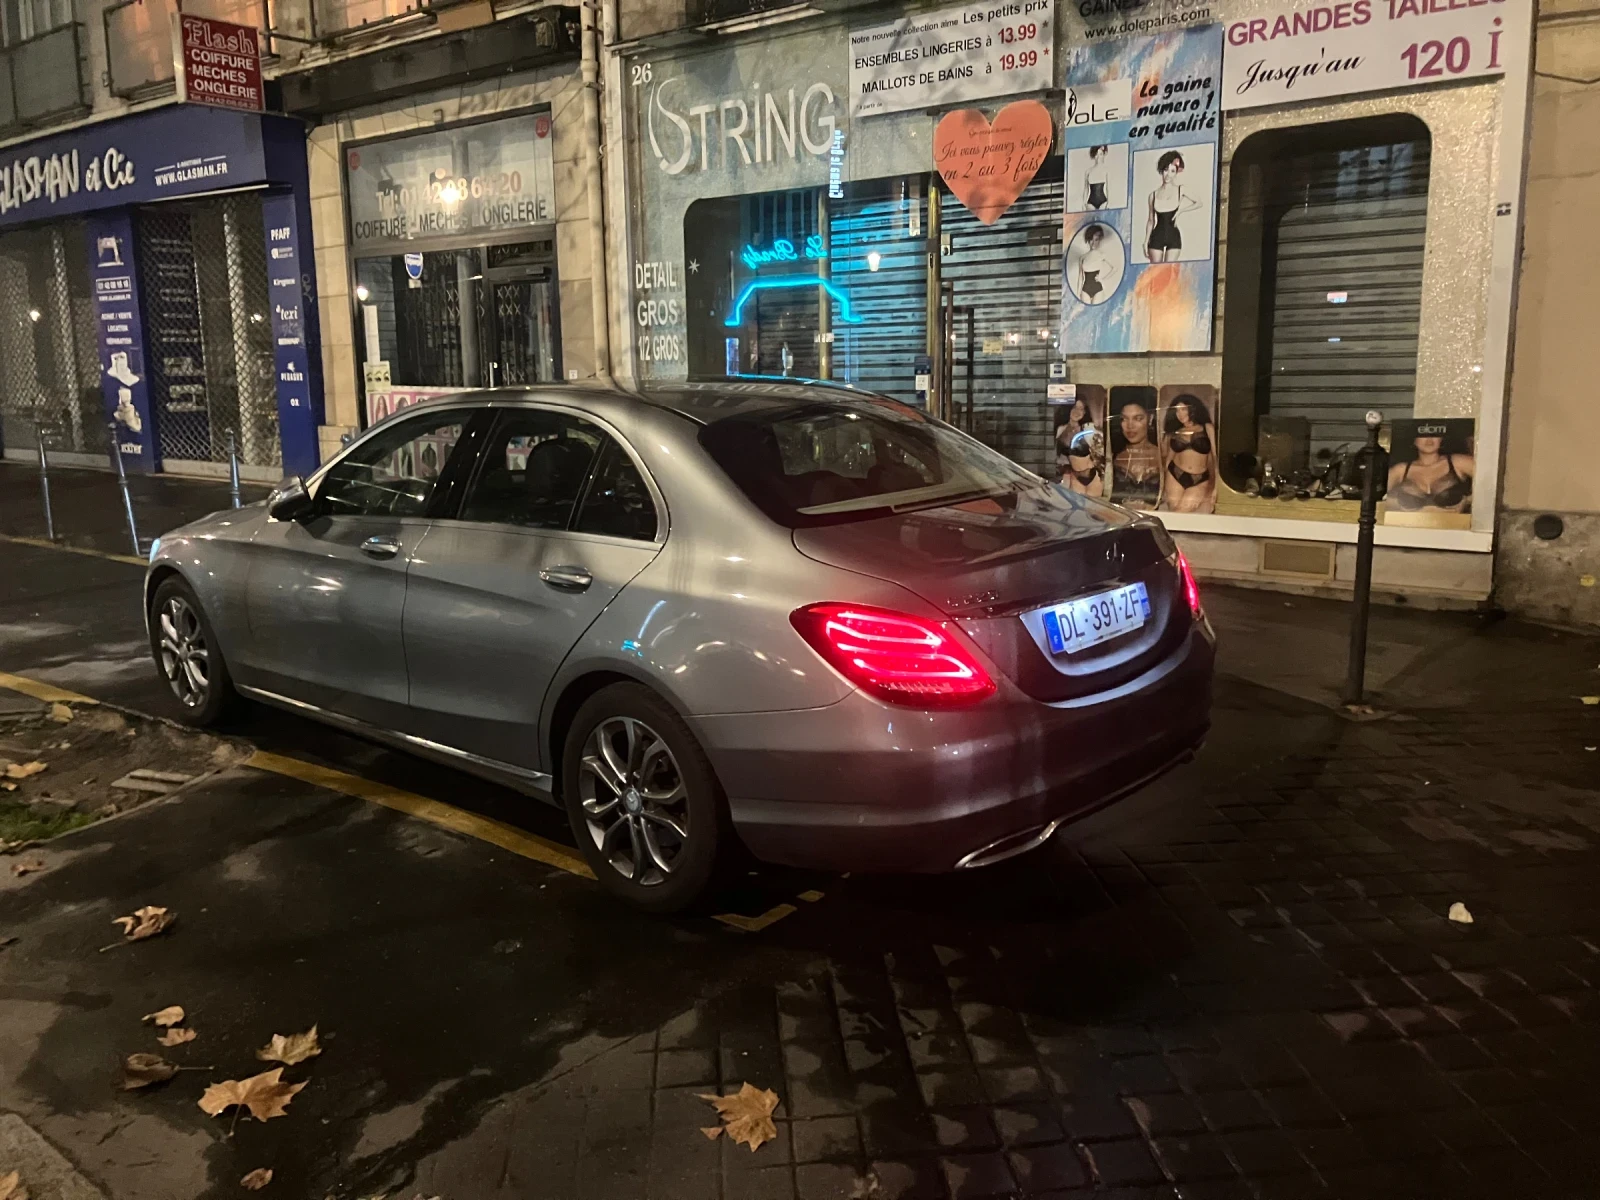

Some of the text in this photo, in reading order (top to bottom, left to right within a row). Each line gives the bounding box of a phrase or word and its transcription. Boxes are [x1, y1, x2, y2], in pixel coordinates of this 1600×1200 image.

[183, 18, 255, 54] Flash
[851, 0, 1048, 45] Notre nouvelle collection aime Les petits prix
[1084, 8, 1210, 39] www.doleparis.com
[1227, 1, 1371, 47] GRANDES
[191, 48, 255, 71] COIFFURE
[855, 23, 1037, 69] ENSEMBLES LINGERIES à 13.99
[192, 64, 247, 84] MECHES
[631, 63, 653, 86] 26
[862, 50, 1038, 94] MAILLOTS DE BAINS à 19.99
[1236, 36, 1471, 95] Jusqu'au 120
[194, 79, 258, 100] ONGLERIE
[1139, 75, 1212, 99] La gaine
[1137, 99, 1200, 119] numero
[1129, 111, 1216, 140] en qualité
[934, 140, 957, 162] Ici
[960, 146, 980, 156] vous
[1020, 134, 1048, 154] régler
[85, 156, 102, 192] et
[103, 147, 136, 190] Cie
[154, 162, 228, 187] WWW.GLASMAN.FR
[944, 170, 959, 180] en
[962, 161, 974, 179] 2
[978, 165, 995, 176] ou
[1002, 157, 1012, 174] 3
[355, 216, 407, 239] COIFFURE
[482, 199, 547, 225] ONGLERIE
[271, 227, 290, 241] PFAFF
[635, 261, 677, 289] DETAIL
[637, 299, 678, 327] GROS
[638, 334, 679, 361] 1/2 GROS
[1418, 423, 1446, 434] elomi
